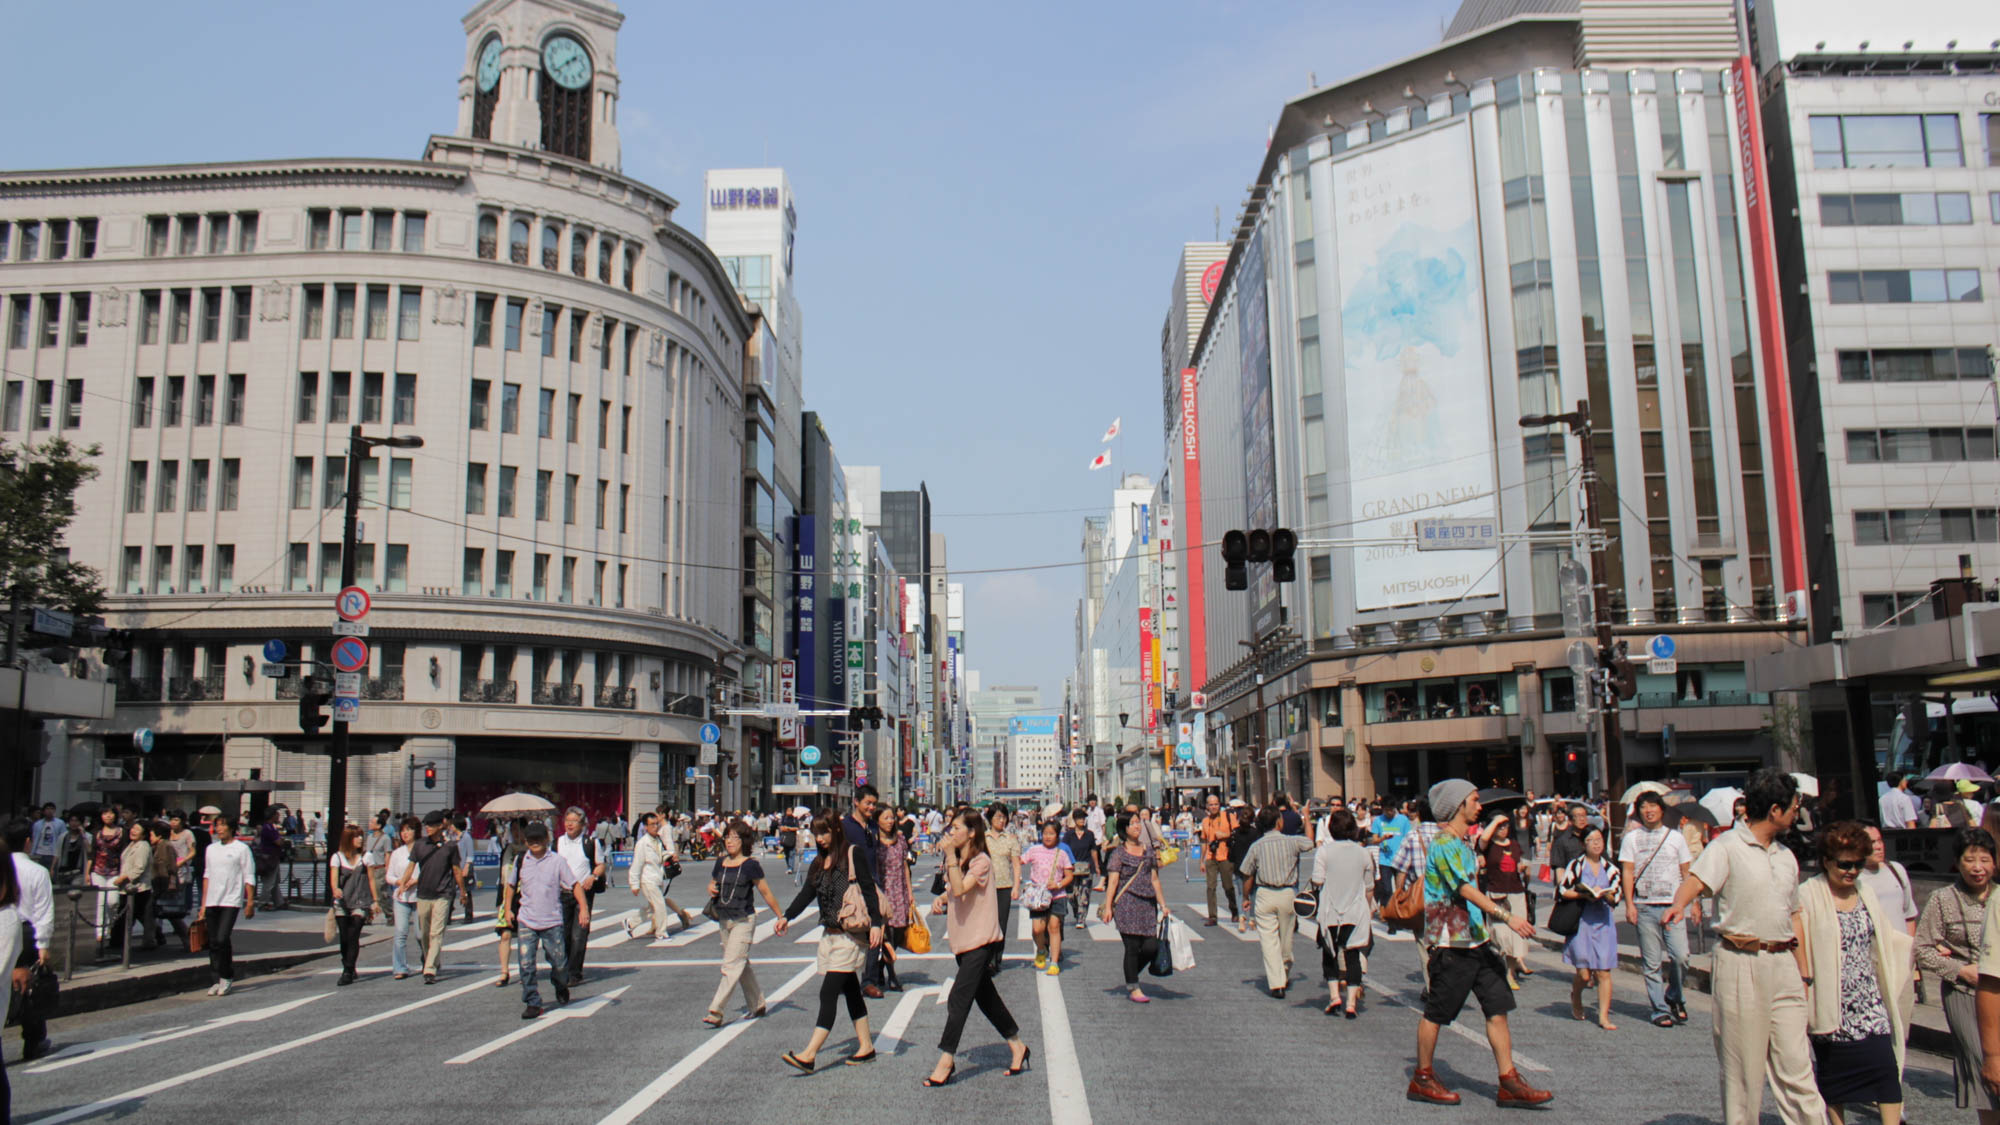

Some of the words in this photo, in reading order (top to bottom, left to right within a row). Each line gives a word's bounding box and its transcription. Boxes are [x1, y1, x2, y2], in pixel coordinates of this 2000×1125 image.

[1732, 68, 1758, 209] MITSUKOSHI
[711, 187, 778, 207] 山野楽器
[1183, 374, 1196, 460] MITSUKOSHI
[1362, 493, 1430, 519] GRAND
[1436, 484, 1481, 504] NEW
[1424, 524, 1493, 540] 銀座四丁目
[800, 555, 813, 632] 山野楽器
[1382, 574, 1470, 596] MITSUKOSHI
[832, 620, 843, 685] MIKIMOTO
